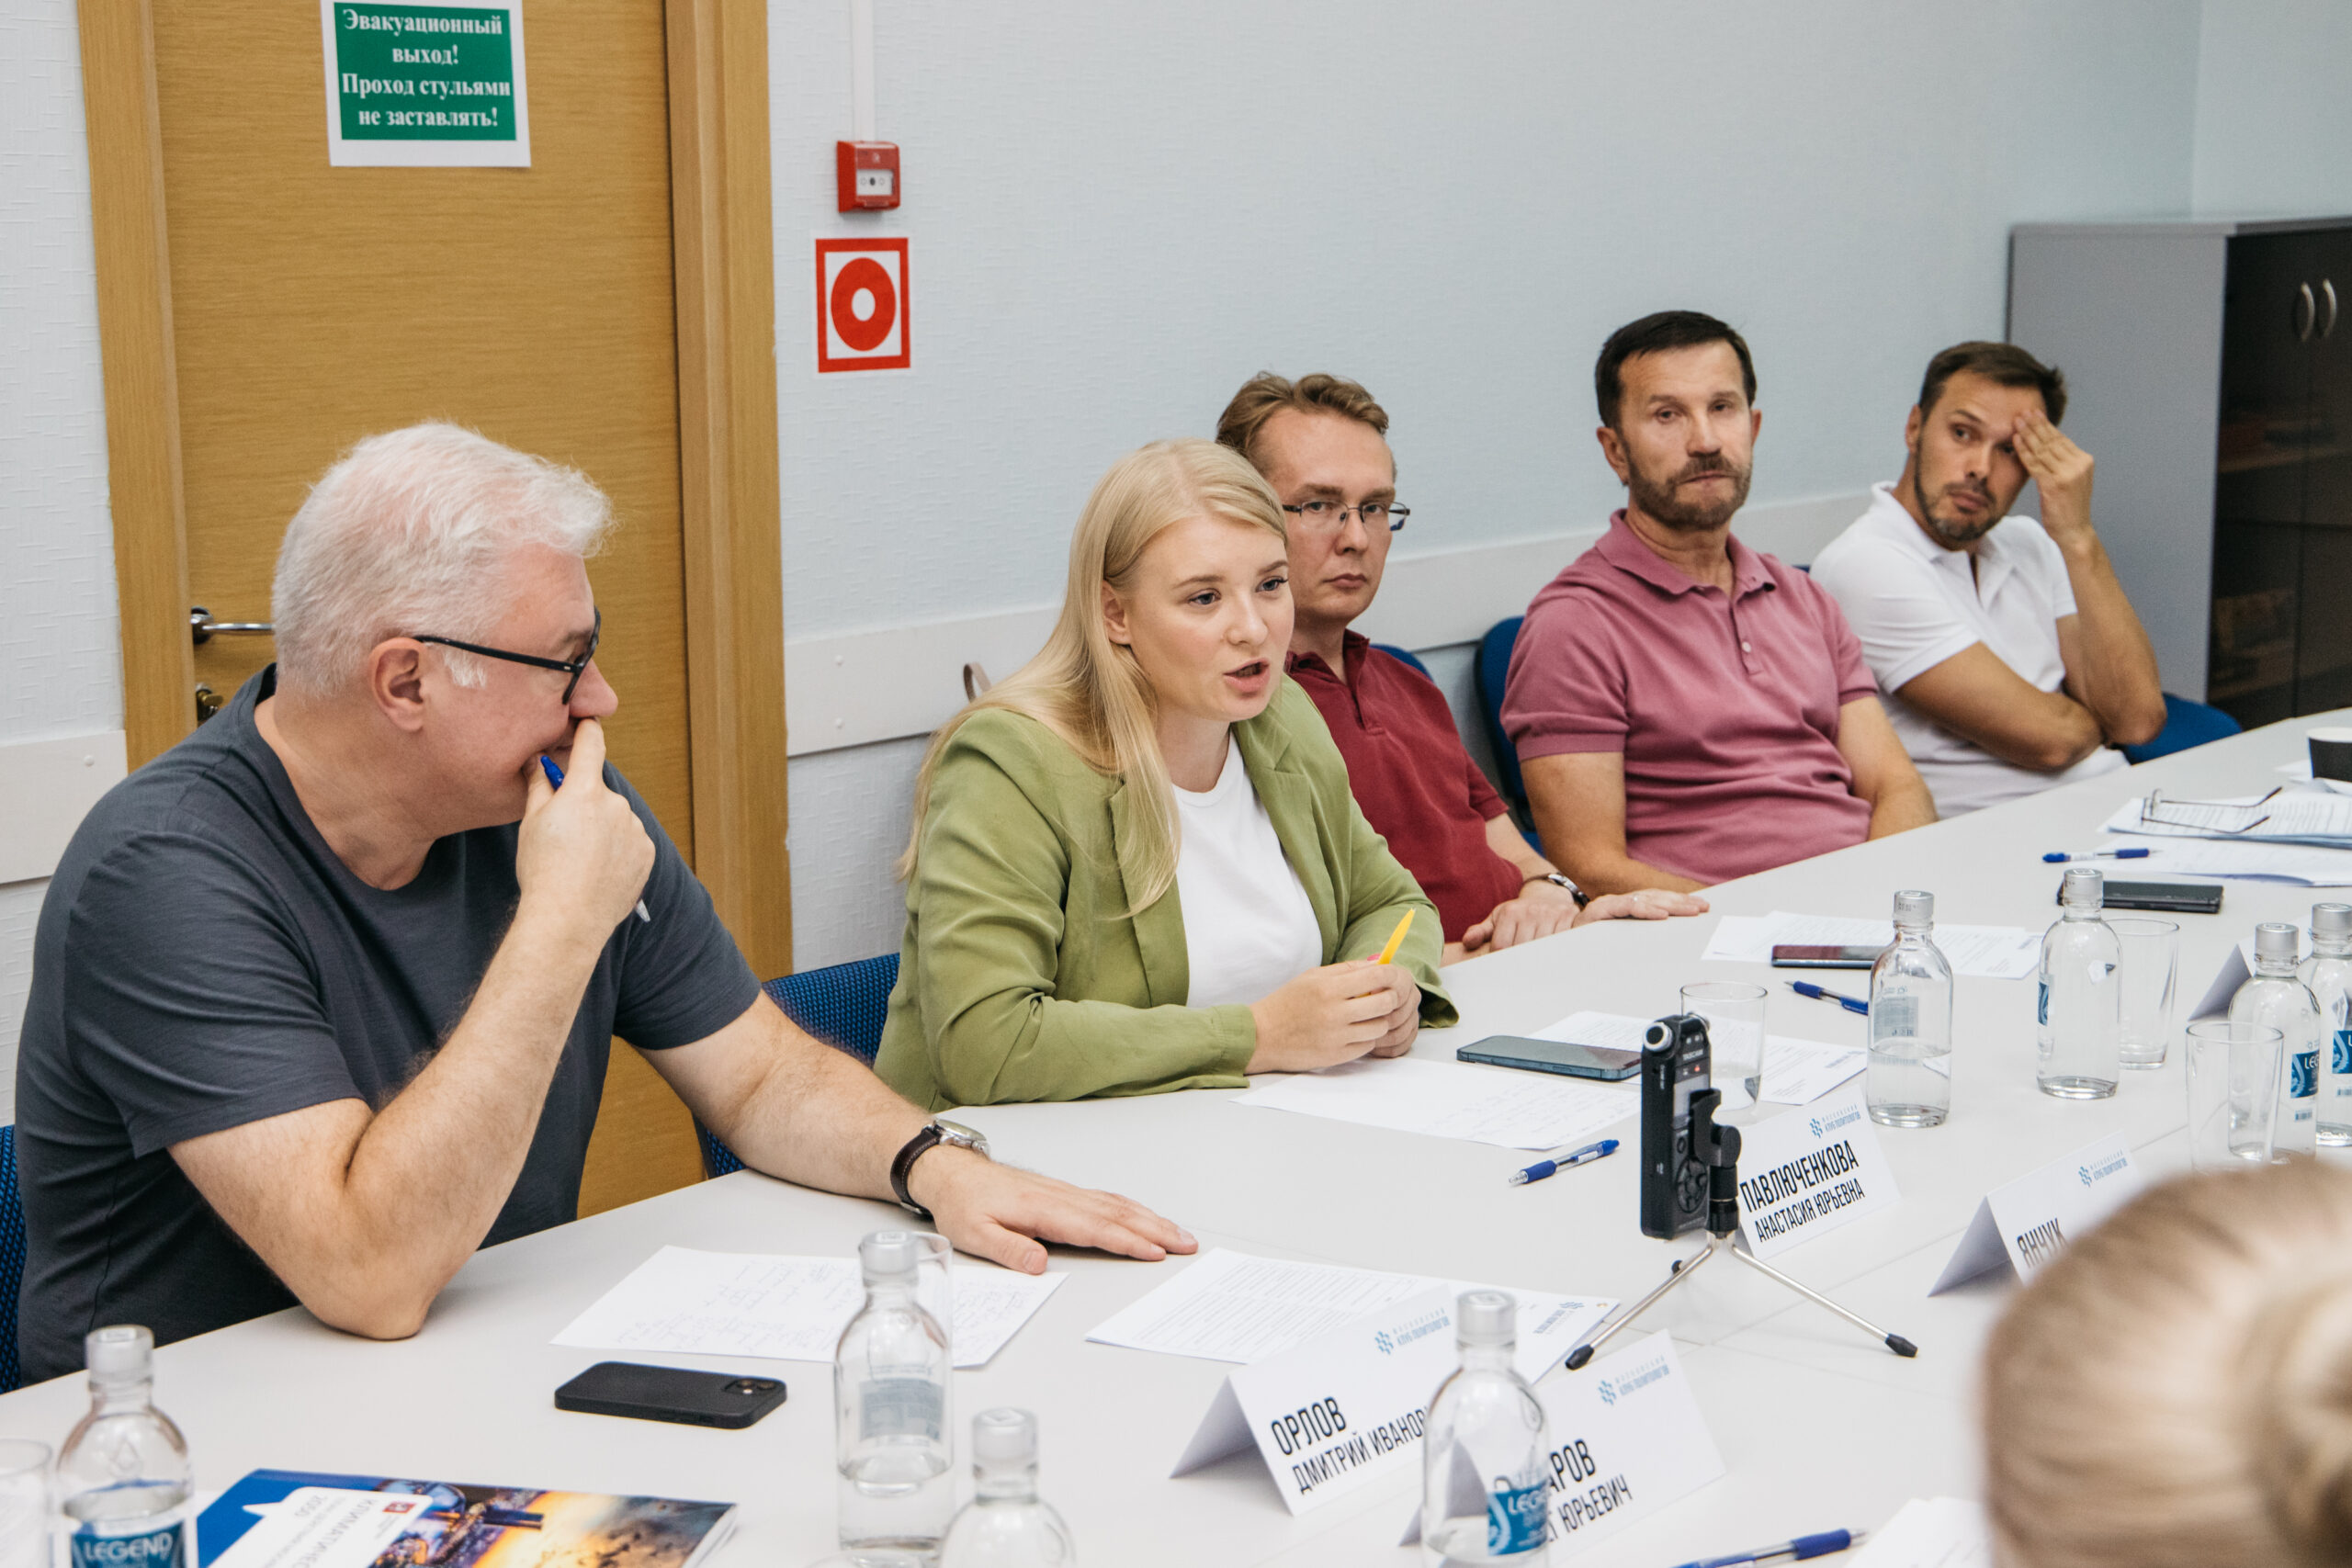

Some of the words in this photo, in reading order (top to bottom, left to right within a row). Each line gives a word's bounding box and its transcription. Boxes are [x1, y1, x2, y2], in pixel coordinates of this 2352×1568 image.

[343, 9, 503, 36] Эвакуационный
[392, 44, 458, 65] выход!
[342, 73, 414, 98] Проход
[419, 80, 511, 100] стульями
[358, 109, 380, 125] не
[386, 107, 498, 127] заставлять!
[1739, 1139, 1860, 1213] ПАВЛЮЧЕНКОВА
[1754, 1198, 1817, 1243] АНАСТАСИЯ
[1813, 1178, 1865, 1215] ЮРЬЕВНА
[1271, 1396, 1347, 1455] ОРЛОВ
[1292, 1431, 1372, 1495] ДМИТРИЙ
[1367, 1406, 1427, 1456] ИВАНОВ
[1507, 1489, 1547, 1516] LEG
[1557, 1473, 1633, 1533] ЮРЬЕВИЧ
[84, 1531, 174, 1562] LEGEND
